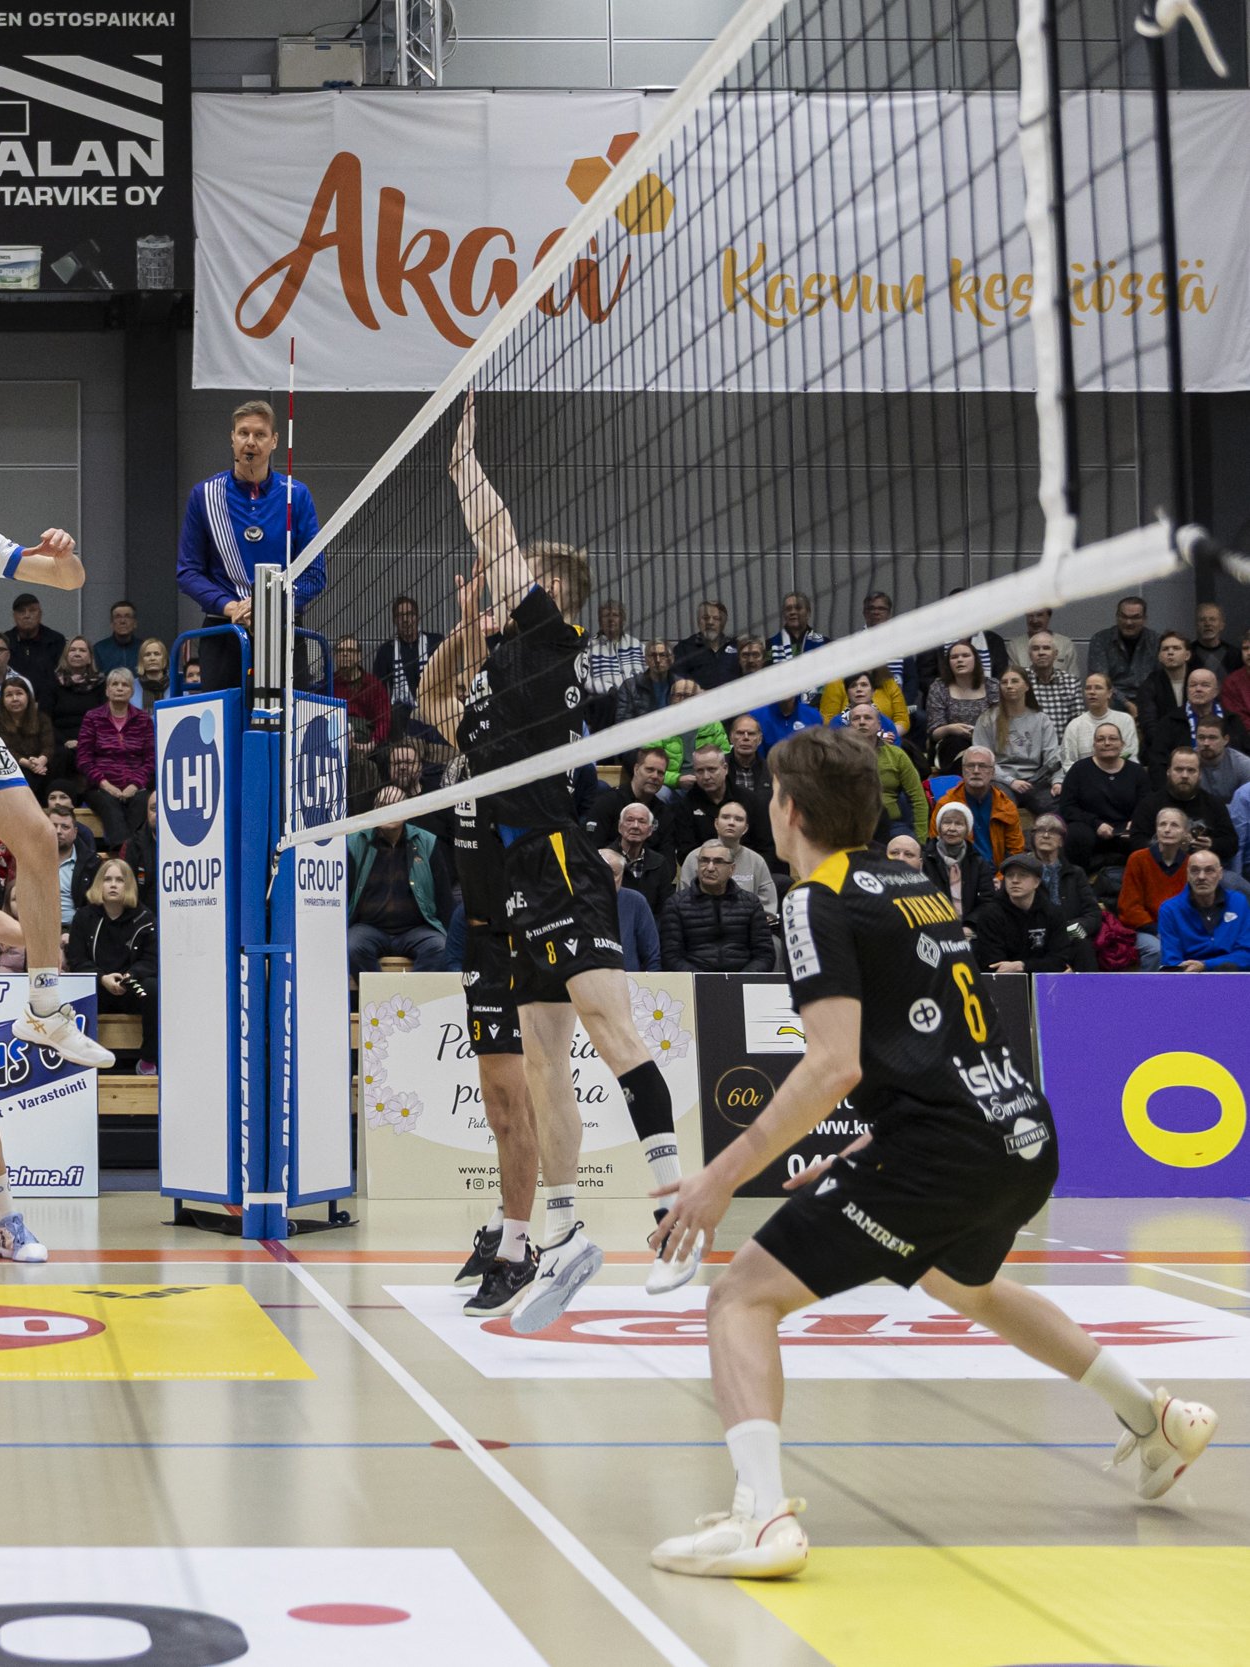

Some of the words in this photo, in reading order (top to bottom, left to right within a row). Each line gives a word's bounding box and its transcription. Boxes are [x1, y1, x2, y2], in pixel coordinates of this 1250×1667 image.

[28, 12, 175, 27] OSTOSPAIKKA!
[125, 186, 164, 206] OY
[235, 151, 631, 349] Akaa
[721, 242, 926, 328] Kasvun
[166, 753, 213, 820] LHJ
[303, 754, 339, 820] LHJ
[162, 858, 222, 892] GROUP
[298, 858, 344, 891] GROUP
[169, 897, 197, 908] YMPÄRISTÖN
[198, 897, 217, 906] HYVÄKSI
[545, 940, 557, 965] 8
[952, 962, 986, 1044] 6
[473, 1019, 482, 1041] 3
[18, 1078, 88, 1110] Varastointi
[1009, 1126, 1045, 1149] TUOVINEN
[841, 1202, 915, 1257] RAMIRENT
